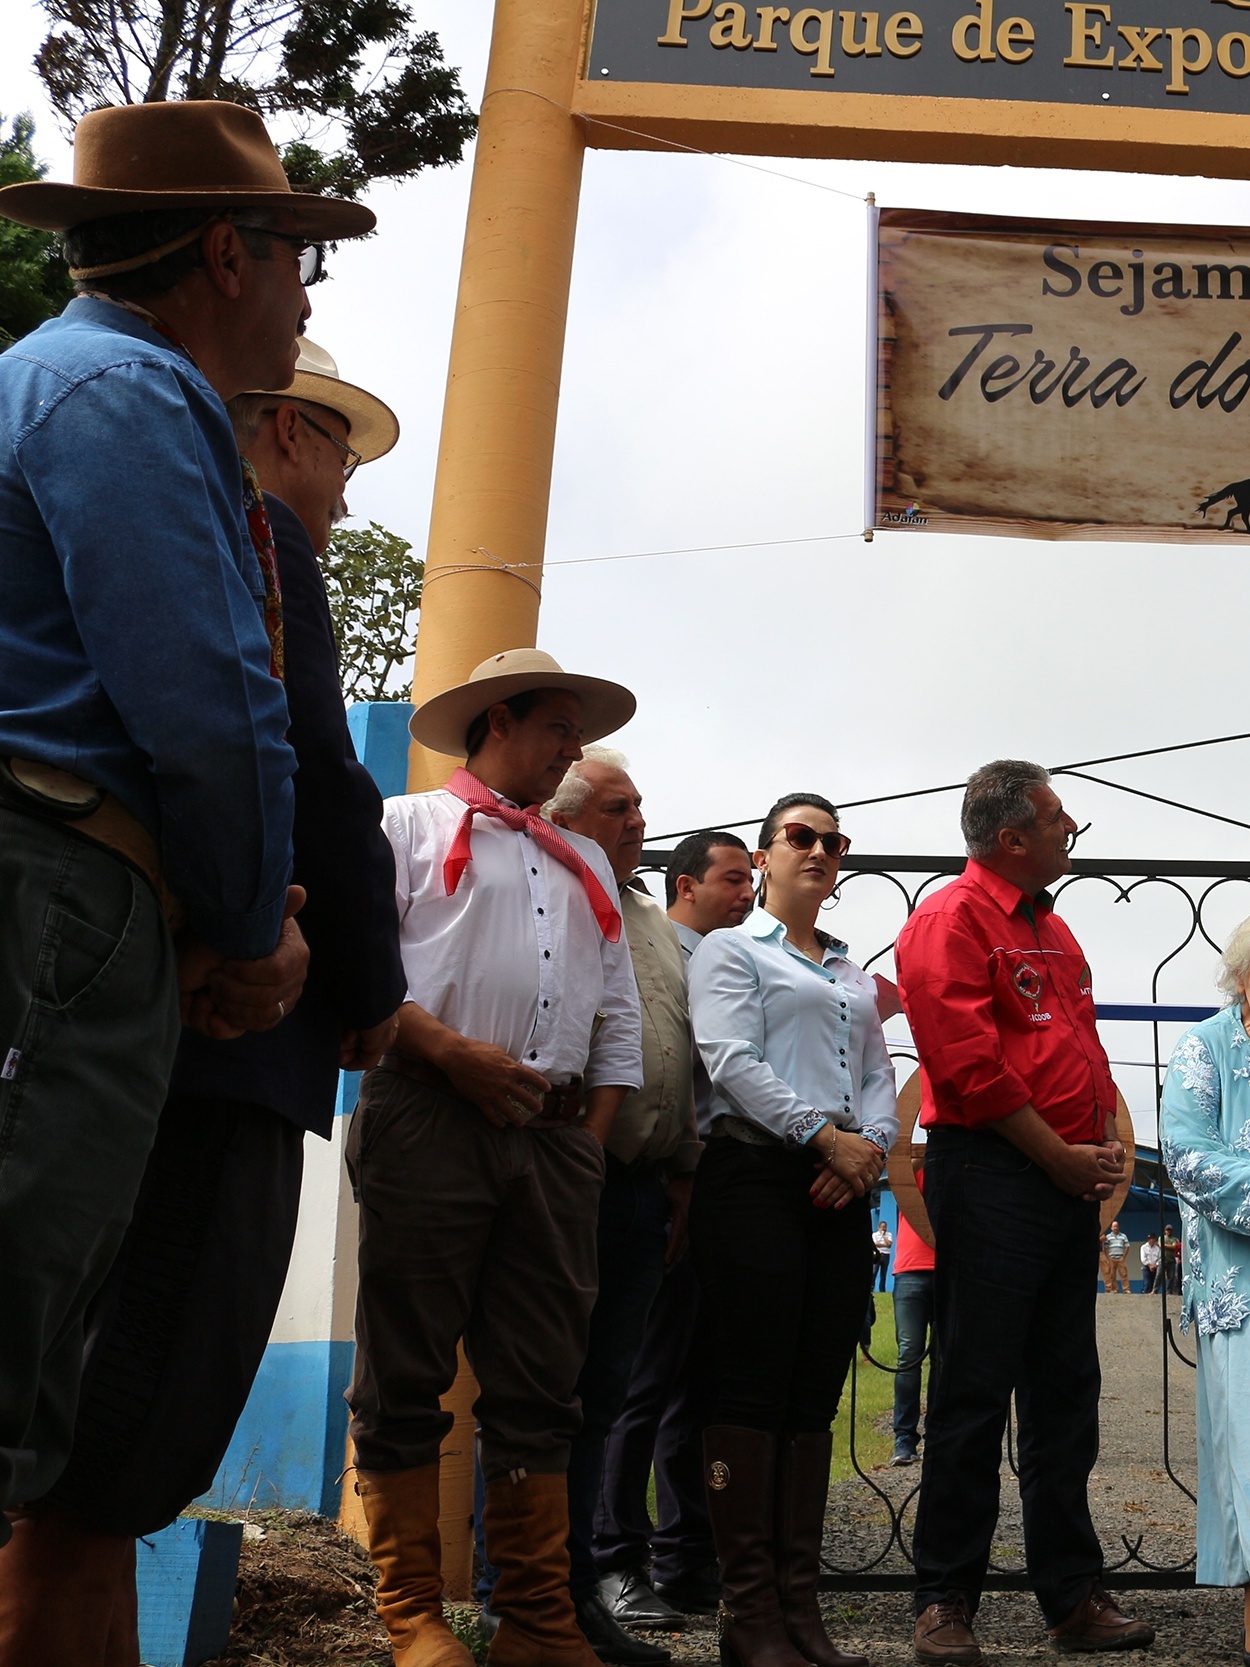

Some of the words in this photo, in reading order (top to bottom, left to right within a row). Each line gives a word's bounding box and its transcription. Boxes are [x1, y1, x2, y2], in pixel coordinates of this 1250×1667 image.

[656, 0, 923, 77] Parque
[951, 0, 1035, 62] de
[937, 323, 1148, 411] Terra
